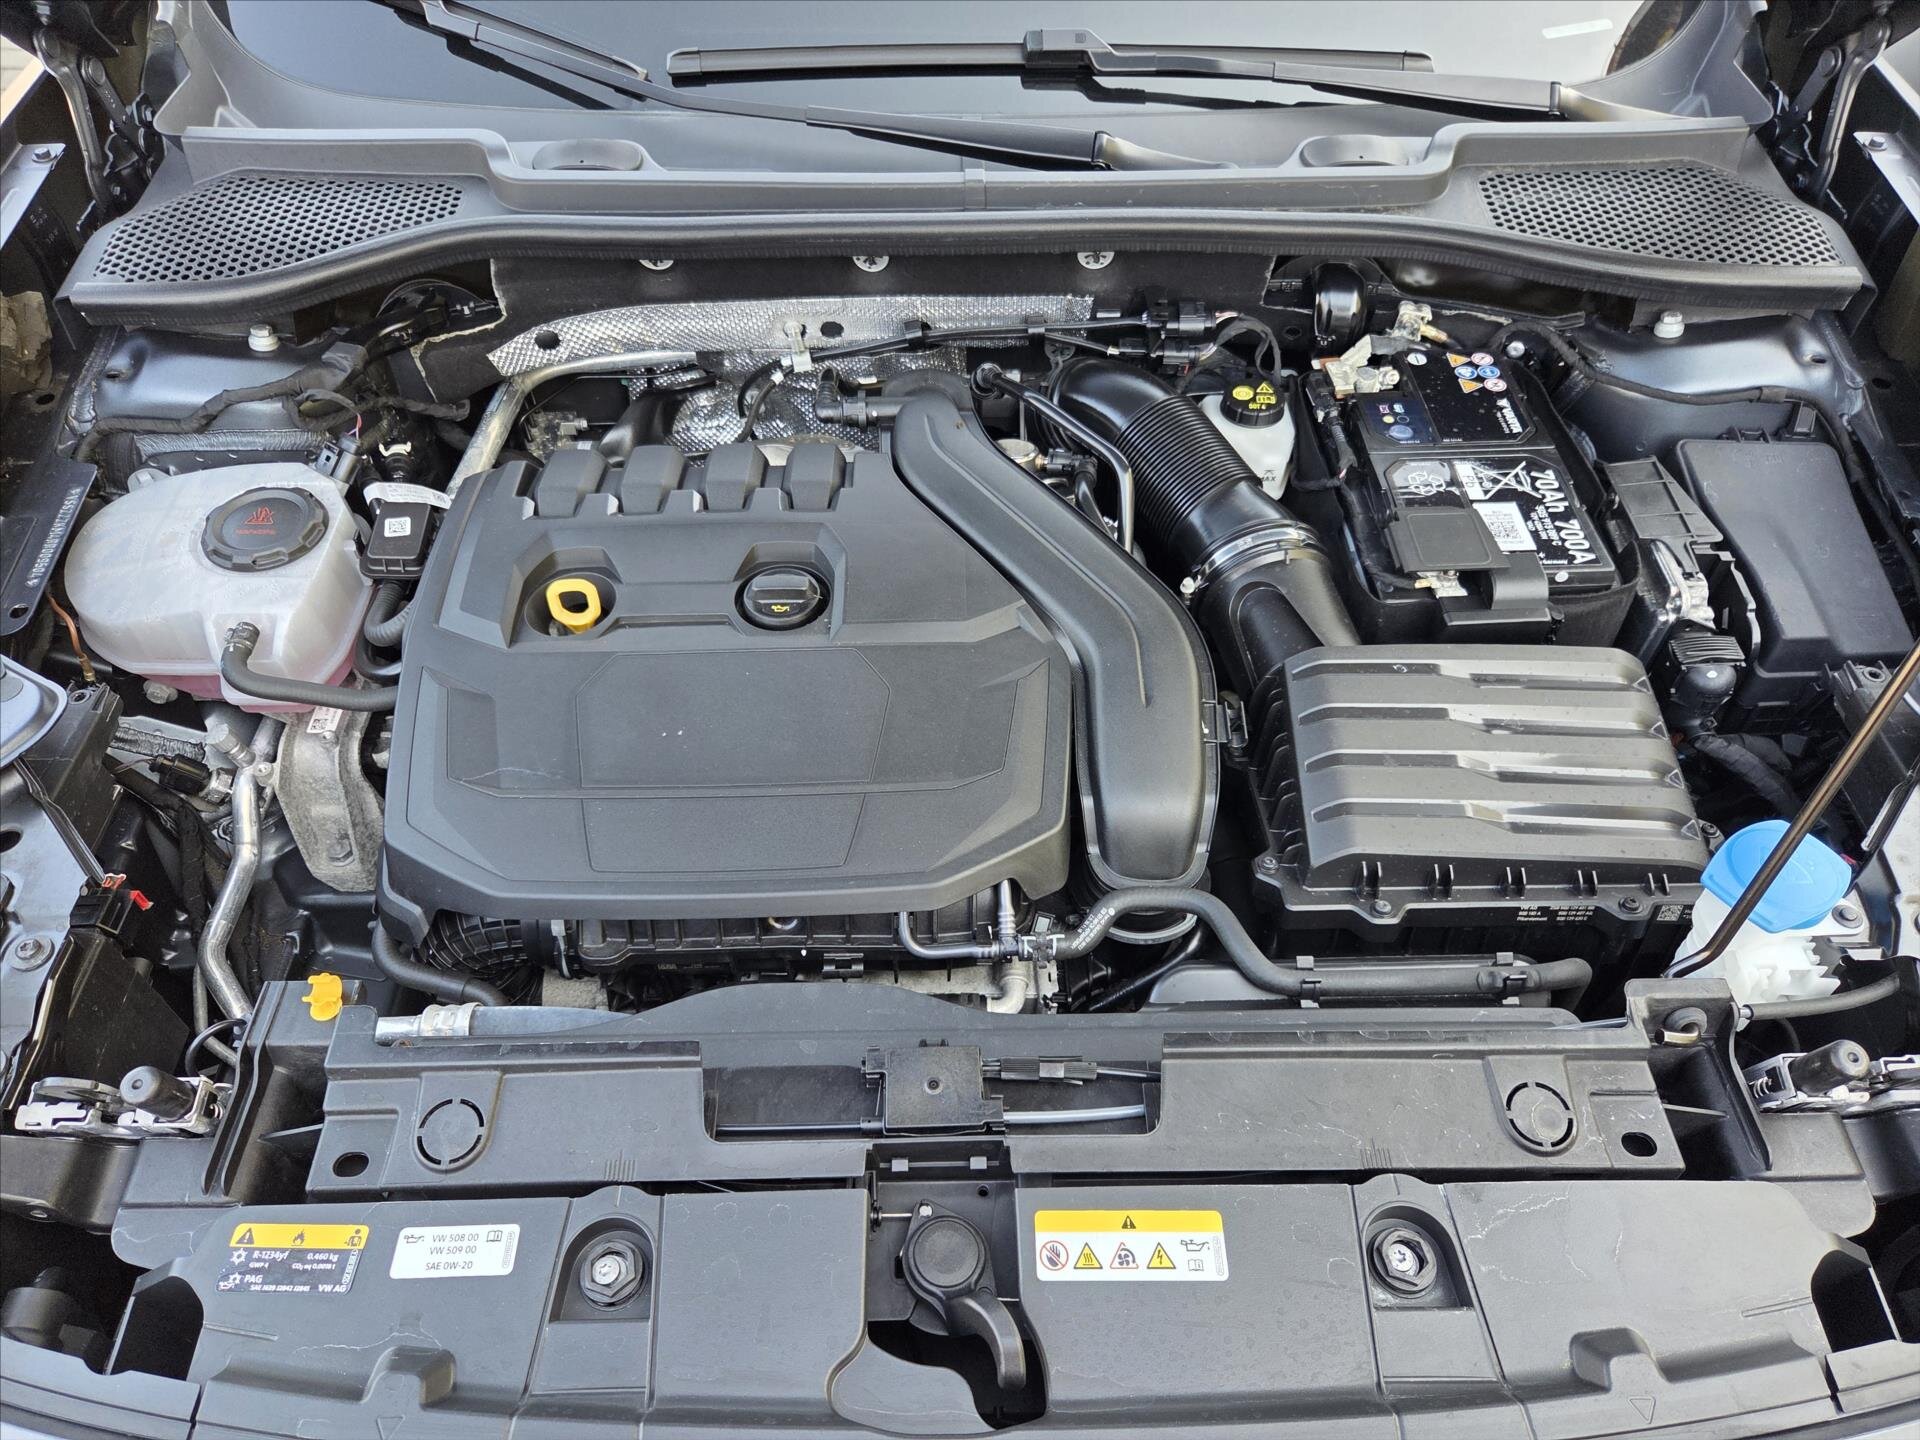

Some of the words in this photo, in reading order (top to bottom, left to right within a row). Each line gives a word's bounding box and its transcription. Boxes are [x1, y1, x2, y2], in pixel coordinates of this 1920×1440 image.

[1530, 469, 1570, 514] 70Ah
[1554, 518, 1597, 565] 700A
[432, 1234, 448, 1243] VW
[448, 1233, 466, 1242] 508
[467, 1233, 480, 1242] 00
[429, 1246, 445, 1255] VW
[446, 1246, 464, 1255] 509
[465, 1245, 477, 1254] 00
[252, 1250, 290, 1262] R-1234yf
[307, 1252, 329, 1261] 0.460
[329, 1252, 339, 1263] kg
[425, 1262, 441, 1271] SAE
[443, 1261, 473, 1270] 0W-20
[244, 1274, 264, 1284] PAG
[318, 1284, 333, 1293] VW
[333, 1284, 348, 1293] AG
